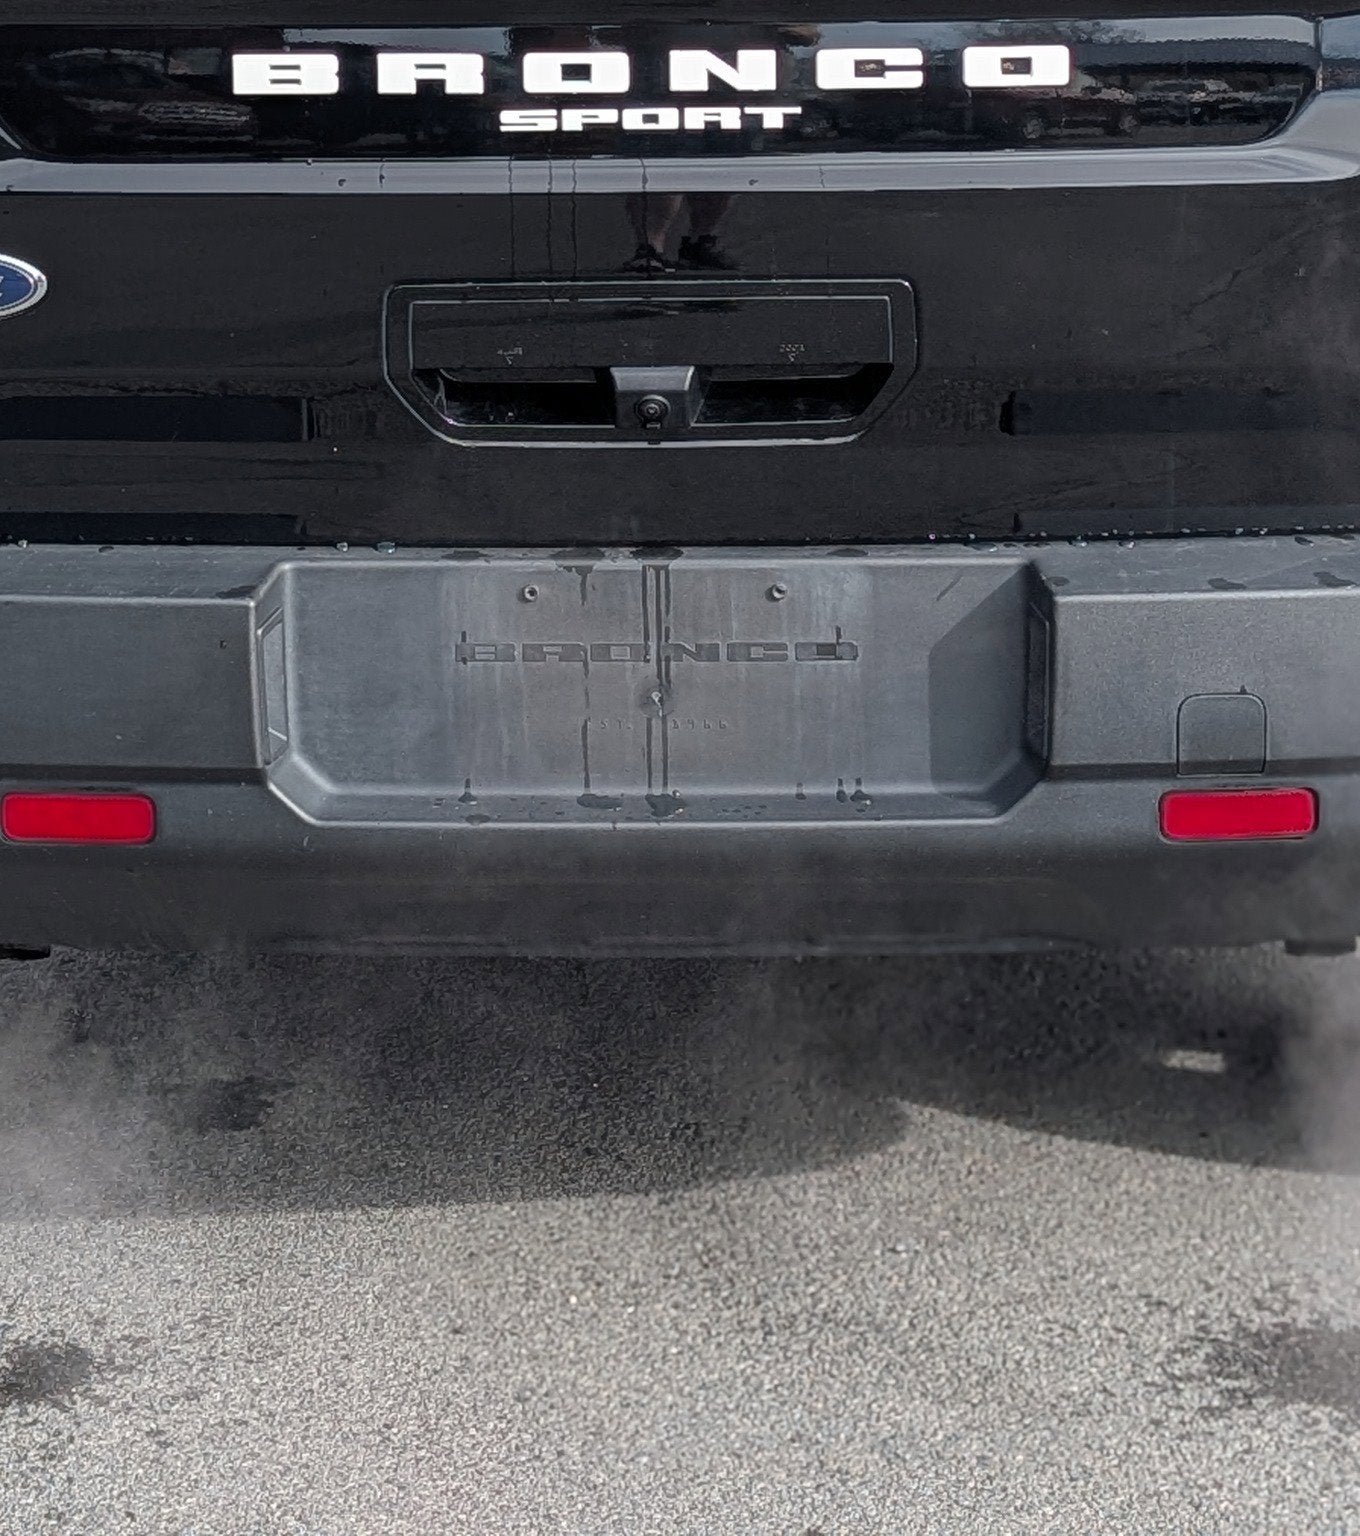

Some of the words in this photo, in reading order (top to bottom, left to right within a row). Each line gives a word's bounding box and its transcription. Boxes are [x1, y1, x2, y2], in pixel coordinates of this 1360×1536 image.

[232, 45, 1071, 95] BRONCO
[499, 106, 802, 132] SPORT
[455, 641, 859, 663] BRONCO
